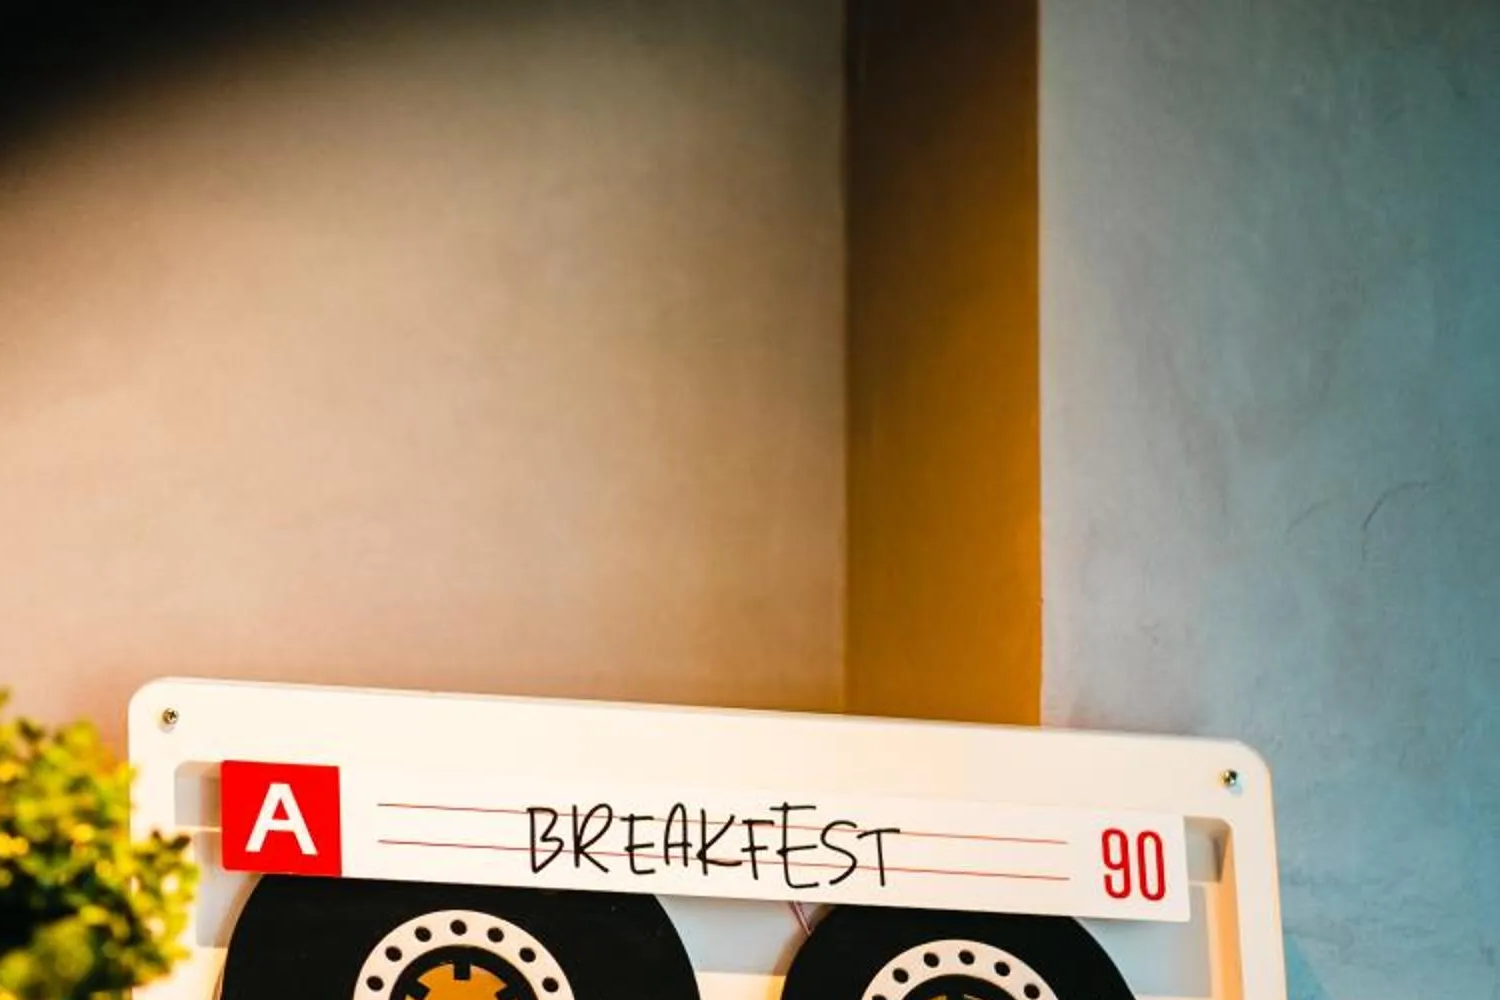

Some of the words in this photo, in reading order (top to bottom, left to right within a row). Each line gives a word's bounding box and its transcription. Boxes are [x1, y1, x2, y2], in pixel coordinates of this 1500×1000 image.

[245, 783, 317, 855] A
[526, 802, 901, 888] BREAKFEST
[1101, 828, 1166, 901] 90
